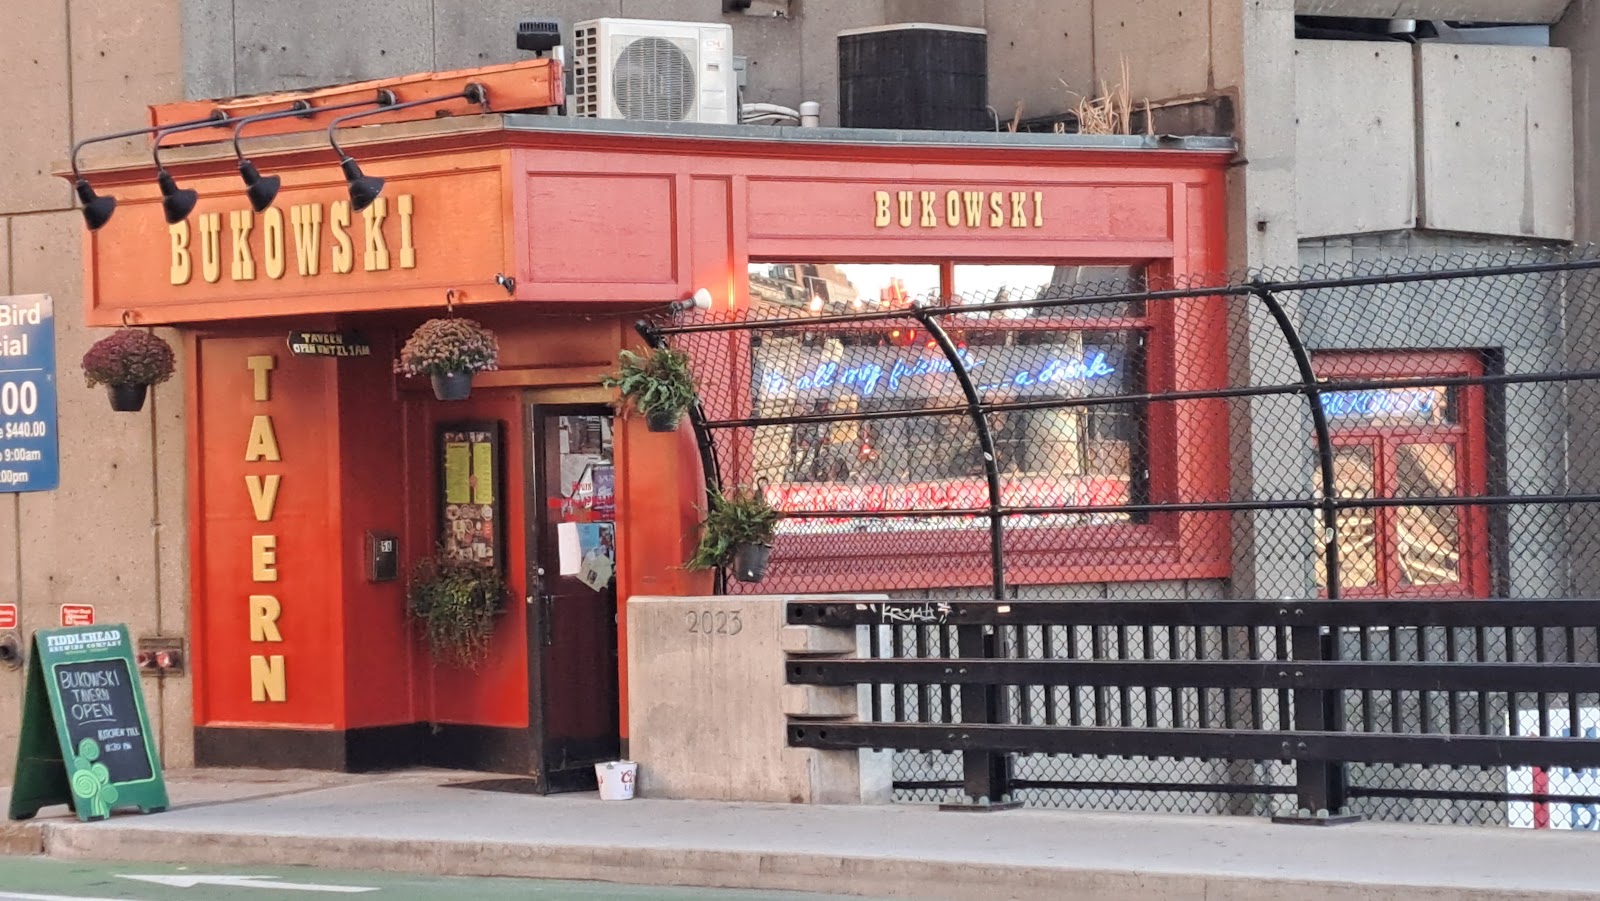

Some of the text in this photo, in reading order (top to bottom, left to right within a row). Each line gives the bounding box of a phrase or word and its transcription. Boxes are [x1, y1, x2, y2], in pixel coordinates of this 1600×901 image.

[874, 189, 1044, 228] BUKOWSKI
[169, 193, 415, 286] BUKOWSKI
[0, 302, 40, 326] Bird
[301, 333, 343, 345] TAVERN
[0, 381, 37, 416] 00
[6, 421, 46, 439] $440.00
[4, 448, 41, 462] 9:00am
[0, 469, 29, 486] 00pm
[244, 354, 287, 703] TAVERN
[685, 608, 743, 636] 2023
[47, 630, 120, 646] FIDDLEHEAD
[60, 670, 120, 689] BUKOWSKI
[71, 688, 110, 703] TAVERN
[71, 703, 113, 720] OPEN
